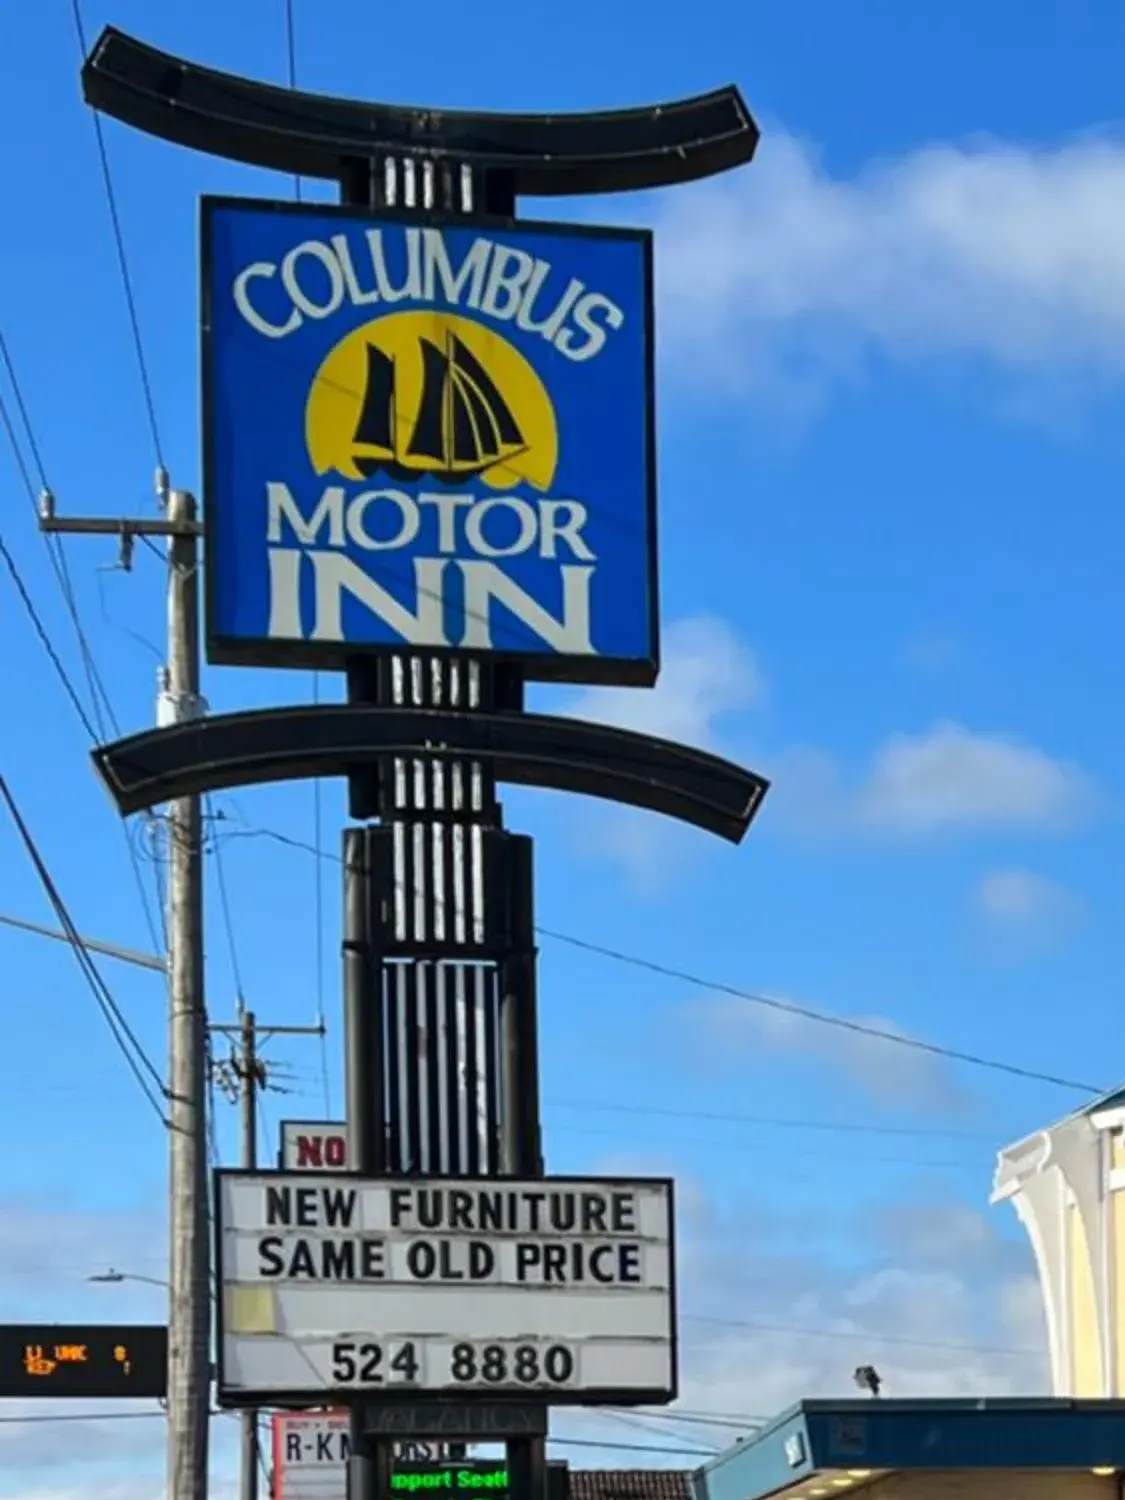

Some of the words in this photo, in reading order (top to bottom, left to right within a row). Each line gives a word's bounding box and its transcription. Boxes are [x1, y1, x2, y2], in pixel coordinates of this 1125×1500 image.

[233, 227, 624, 362] COLUMBUS
[266, 481, 598, 561] MOTOR
[267, 547, 600, 656] INN
[296, 1135, 346, 1167] NO
[265, 1186, 357, 1228] NEW
[389, 1188, 636, 1232] FURNITURE
[258, 1237, 385, 1280] SAME
[406, 1240, 495, 1281] OLD
[516, 1243, 642, 1283] PRICE
[332, 1342, 419, 1383] 524
[451, 1342, 574, 1383] 8880
[391, 1470, 452, 1492] pport
